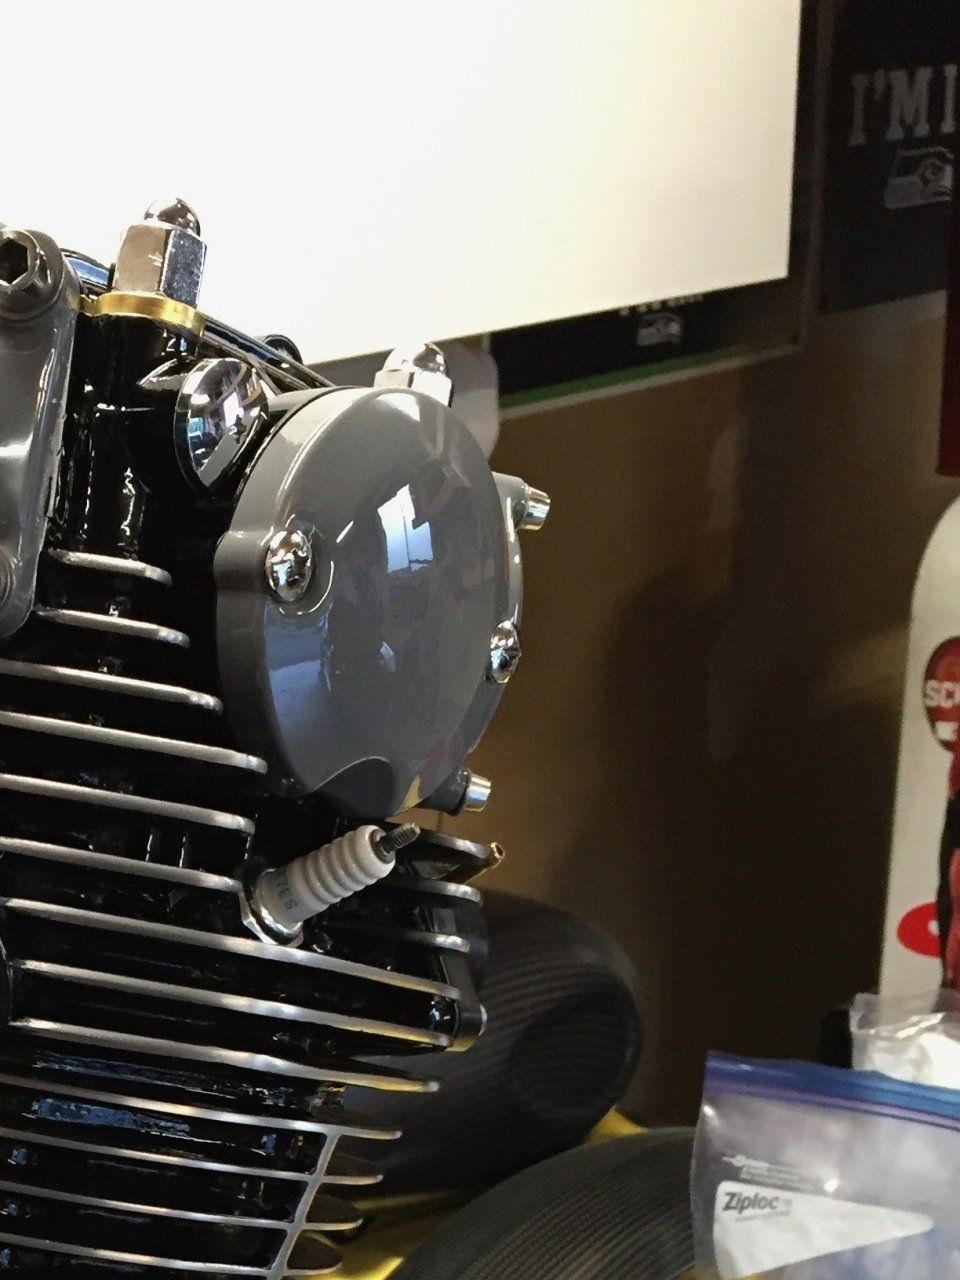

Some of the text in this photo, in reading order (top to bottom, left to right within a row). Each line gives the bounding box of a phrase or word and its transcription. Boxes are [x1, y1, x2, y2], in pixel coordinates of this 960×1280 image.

[849, 66, 933, 146] I'M
[925, 679, 960, 708] SC
[723, 1192, 781, 1215] Ziploc
